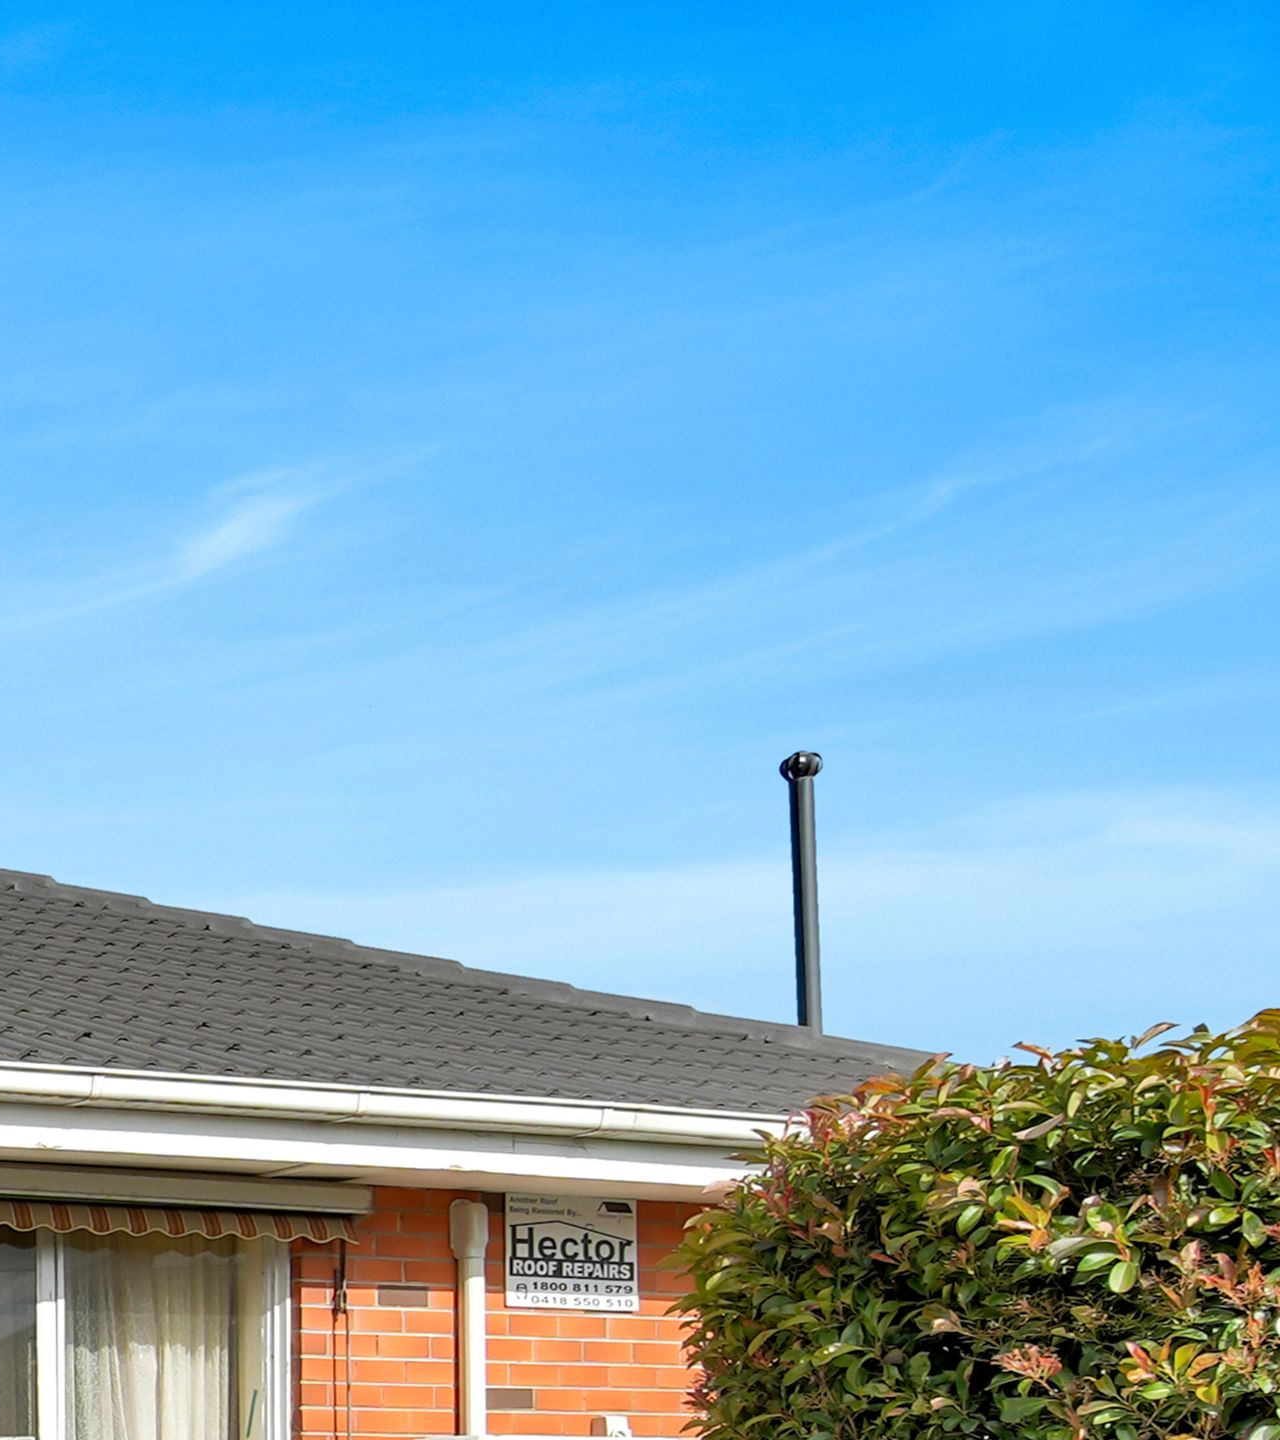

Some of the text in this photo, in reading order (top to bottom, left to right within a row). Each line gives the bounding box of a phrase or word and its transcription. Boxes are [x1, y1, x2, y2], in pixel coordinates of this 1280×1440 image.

[511, 1226, 633, 1263] Hector
[512, 1260, 632, 1280] ROOF REPAIRS
[532, 1281, 633, 1295] 1800 811 579
[531, 1295, 568, 1306] 0418
